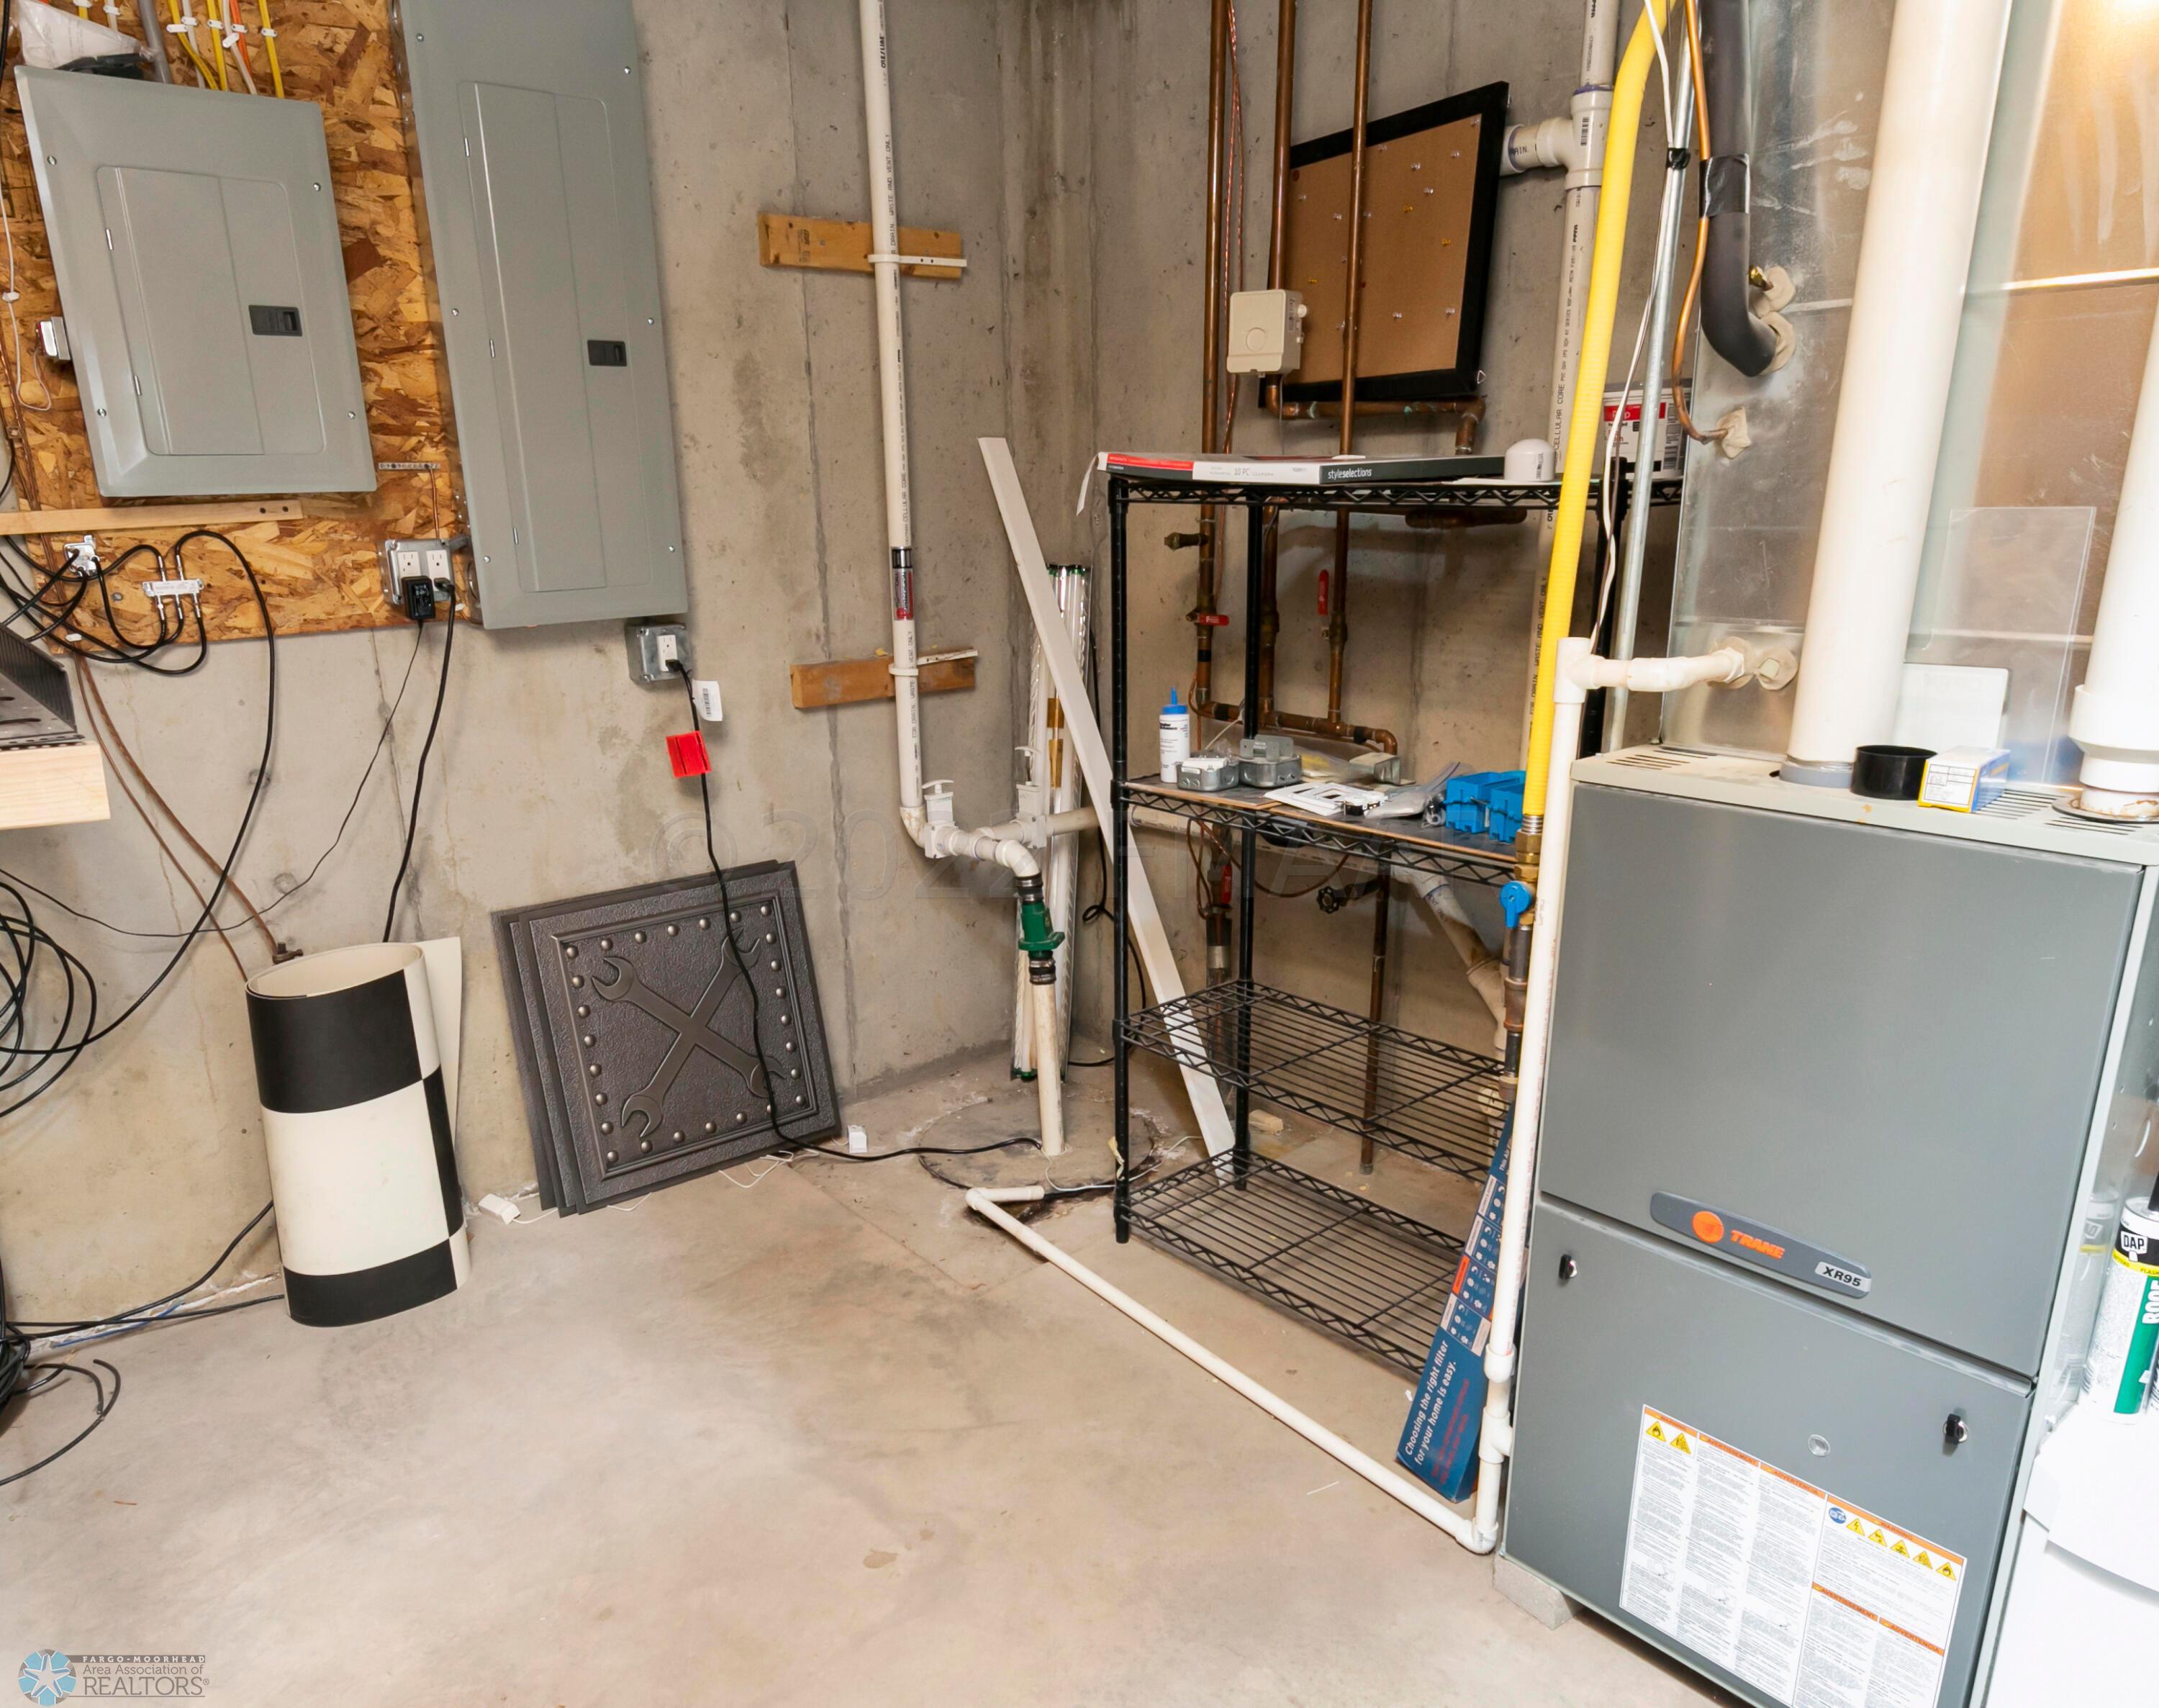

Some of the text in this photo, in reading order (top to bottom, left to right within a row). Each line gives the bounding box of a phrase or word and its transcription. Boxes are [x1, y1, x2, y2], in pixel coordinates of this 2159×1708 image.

[1554, 409, 1562, 450] CELLULAR
[1328, 467, 1372, 480] styleselections
[1731, 1229, 1862, 1287] TRANE XR95
[2124, 1234, 2145, 1250] DAP
[1406, 1340, 1449, 1455] Choosing the right filter
[1415, 1361, 1457, 1465] for your home is easy.
[1880, 1521, 1914, 1541] WARNING
